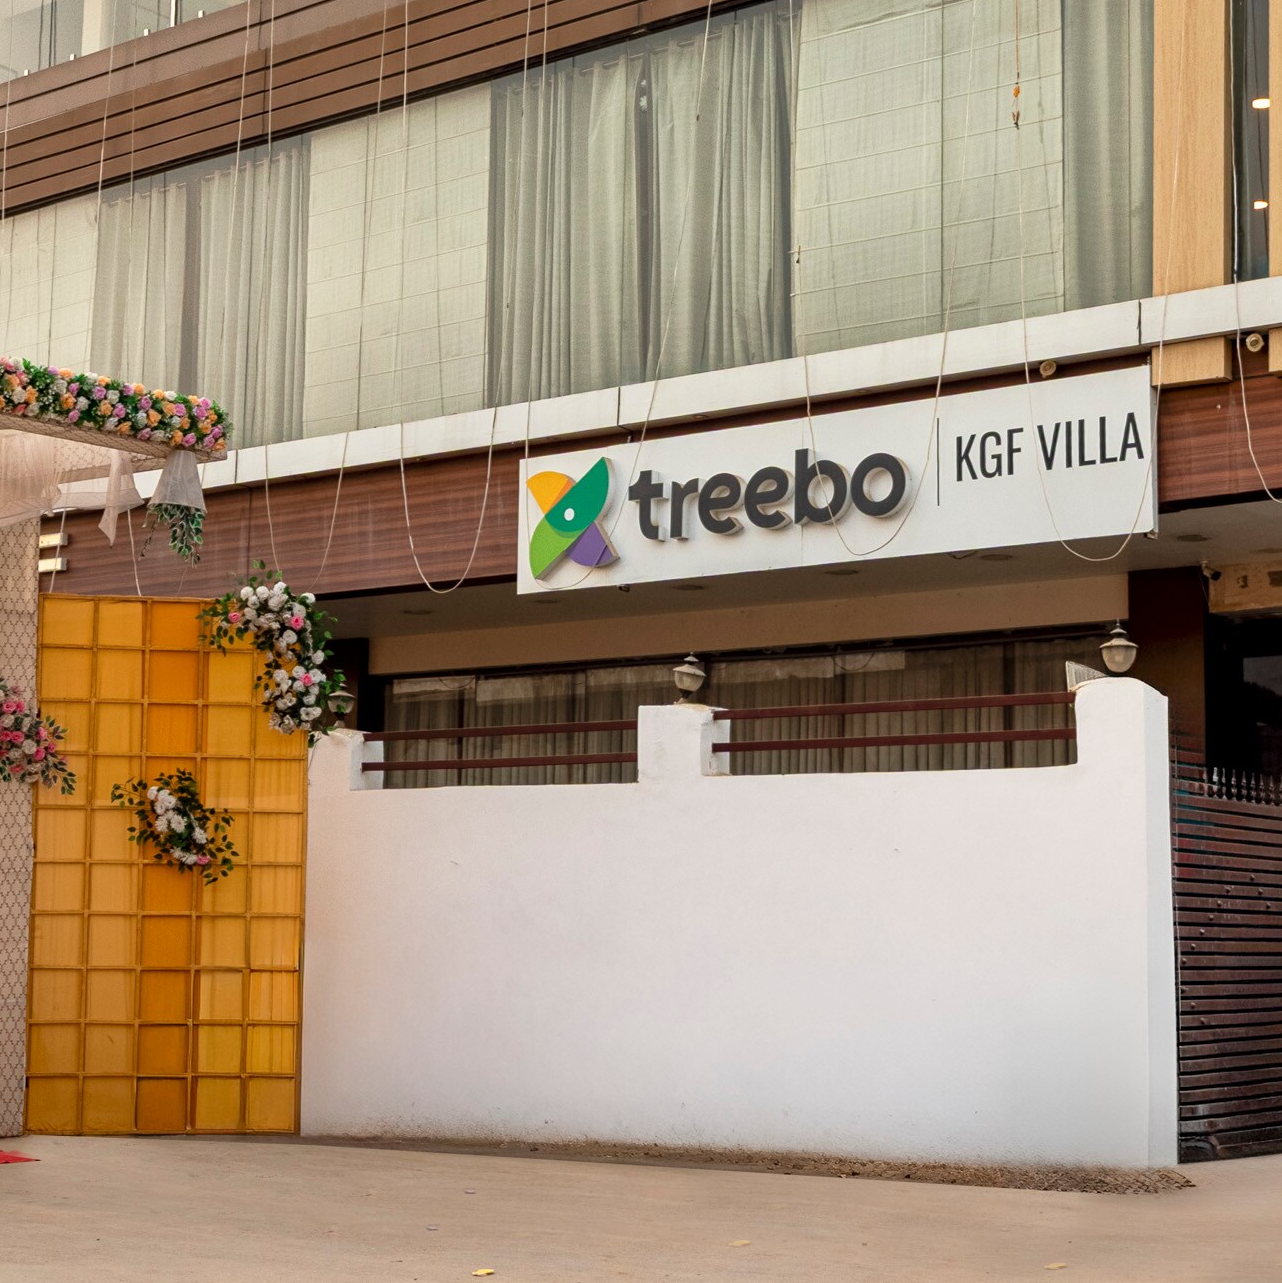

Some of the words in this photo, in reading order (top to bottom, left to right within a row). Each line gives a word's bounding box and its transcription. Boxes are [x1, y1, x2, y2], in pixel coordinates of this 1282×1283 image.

[956, 427, 1024, 481] KGF
[1037, 412, 1145, 470] VILLA
[628, 448, 908, 543] treebo
